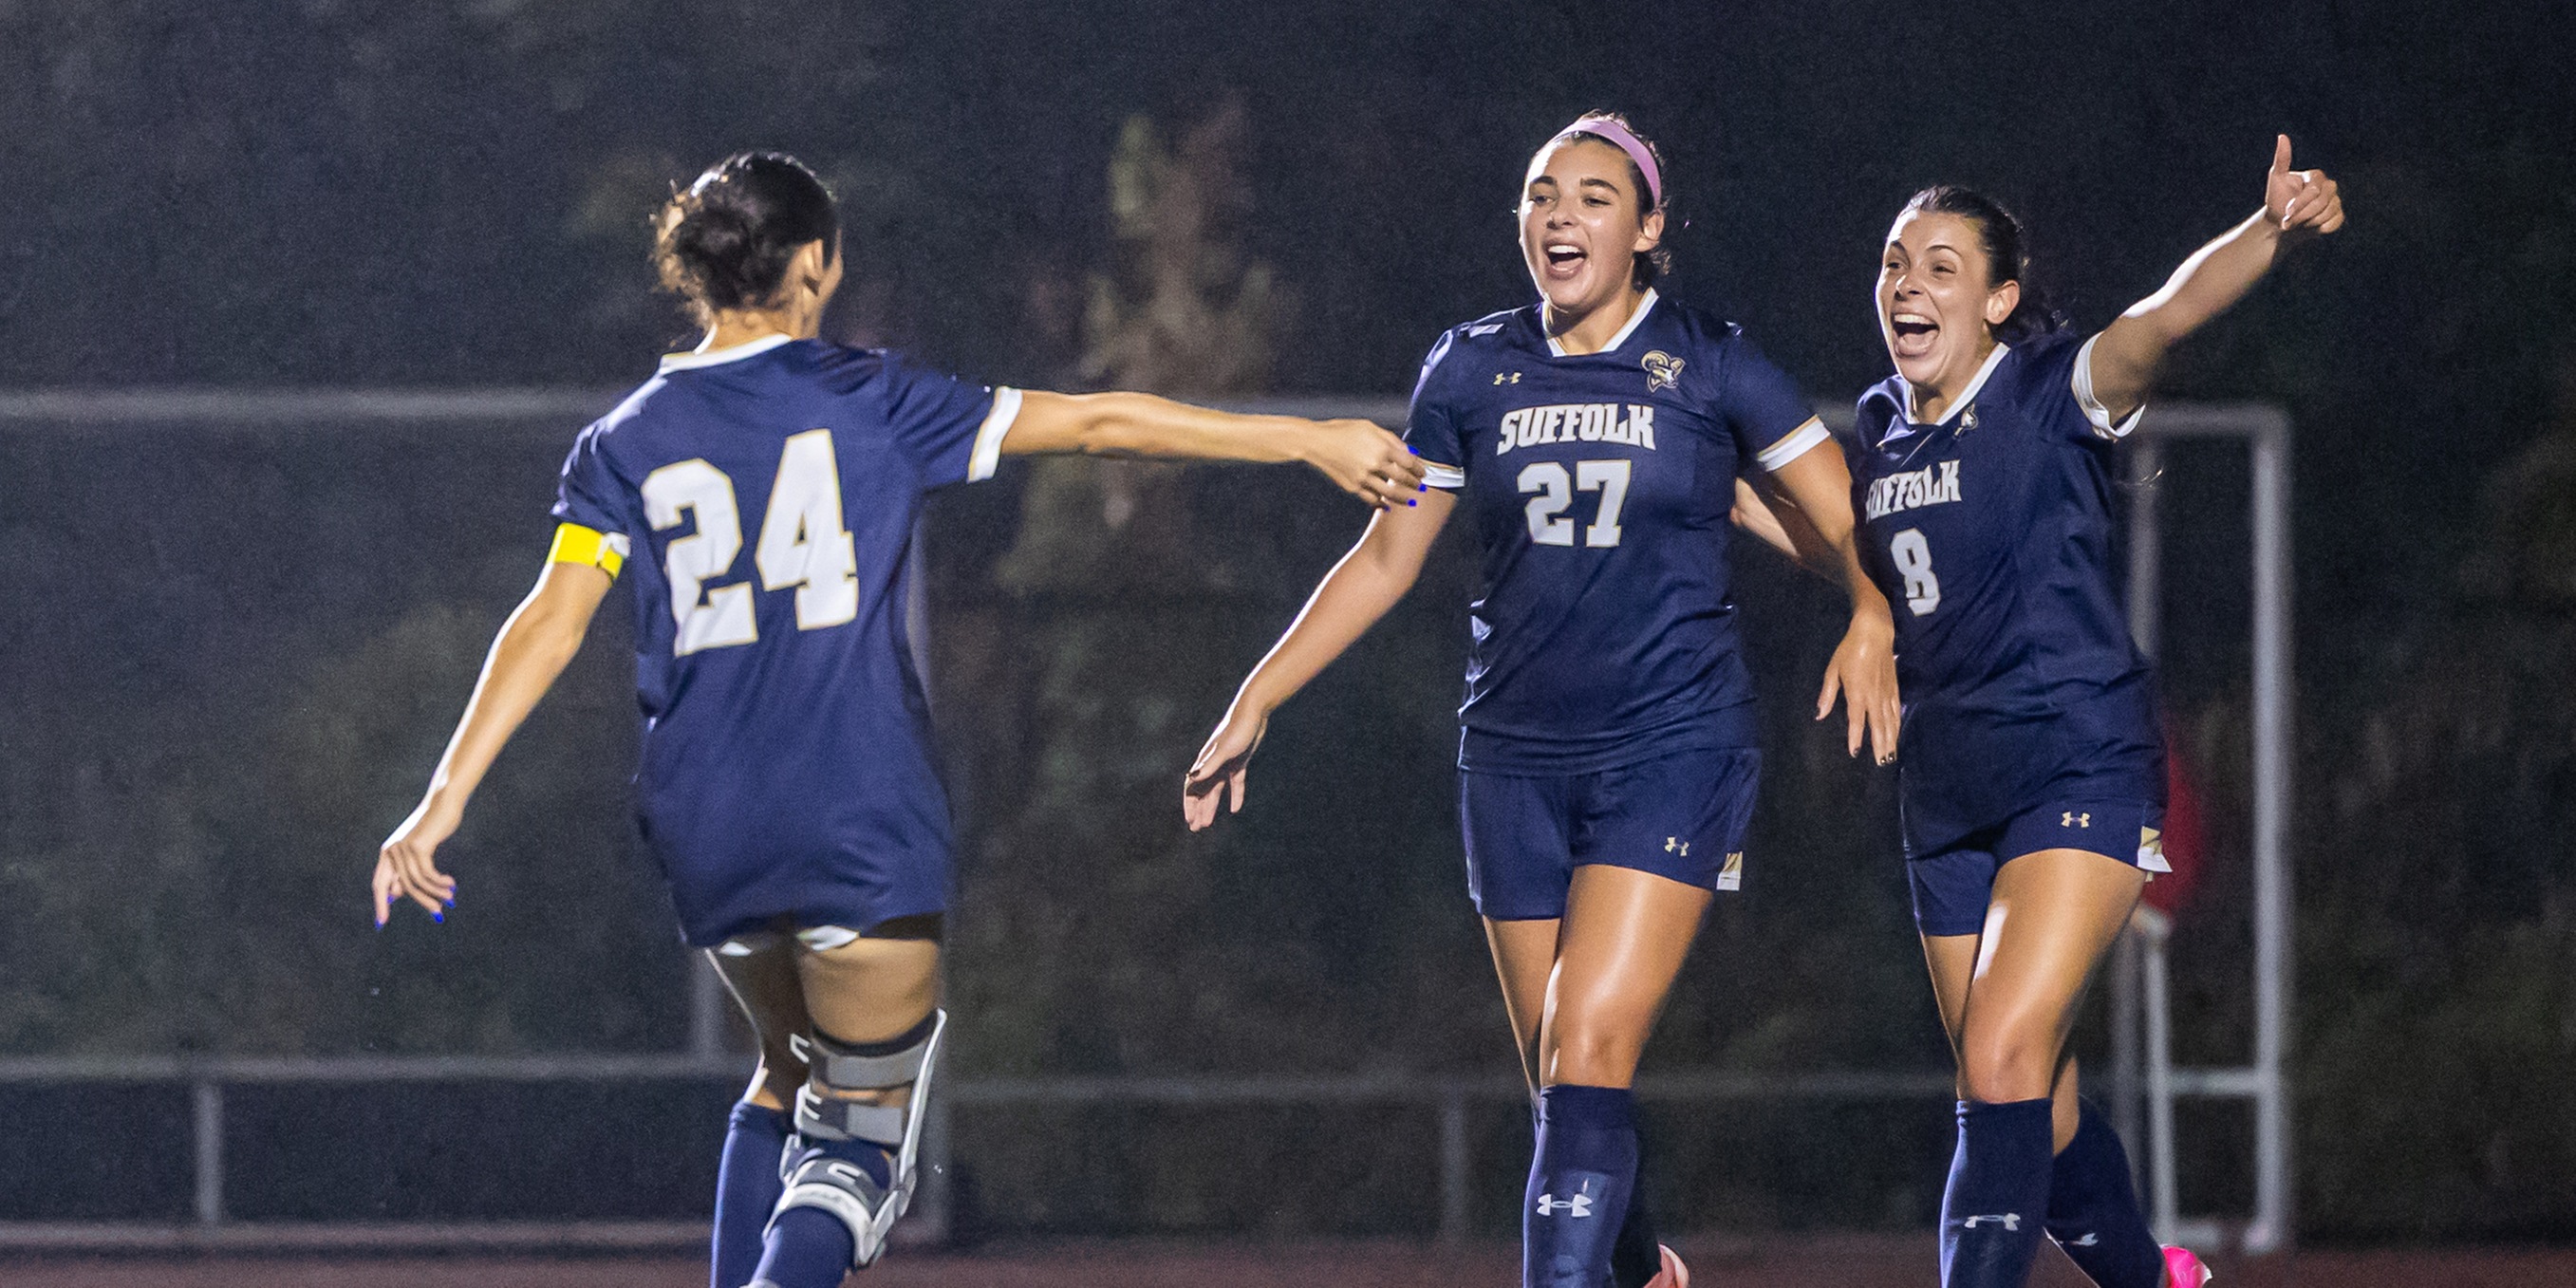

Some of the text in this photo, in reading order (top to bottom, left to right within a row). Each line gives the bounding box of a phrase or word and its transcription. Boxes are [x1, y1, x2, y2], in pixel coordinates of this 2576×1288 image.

[1496, 403, 1656, 456] SUFFOLK
[641, 428, 859, 657] 24
[1517, 459, 1632, 548] 27
[1890, 528, 1941, 617] 8
